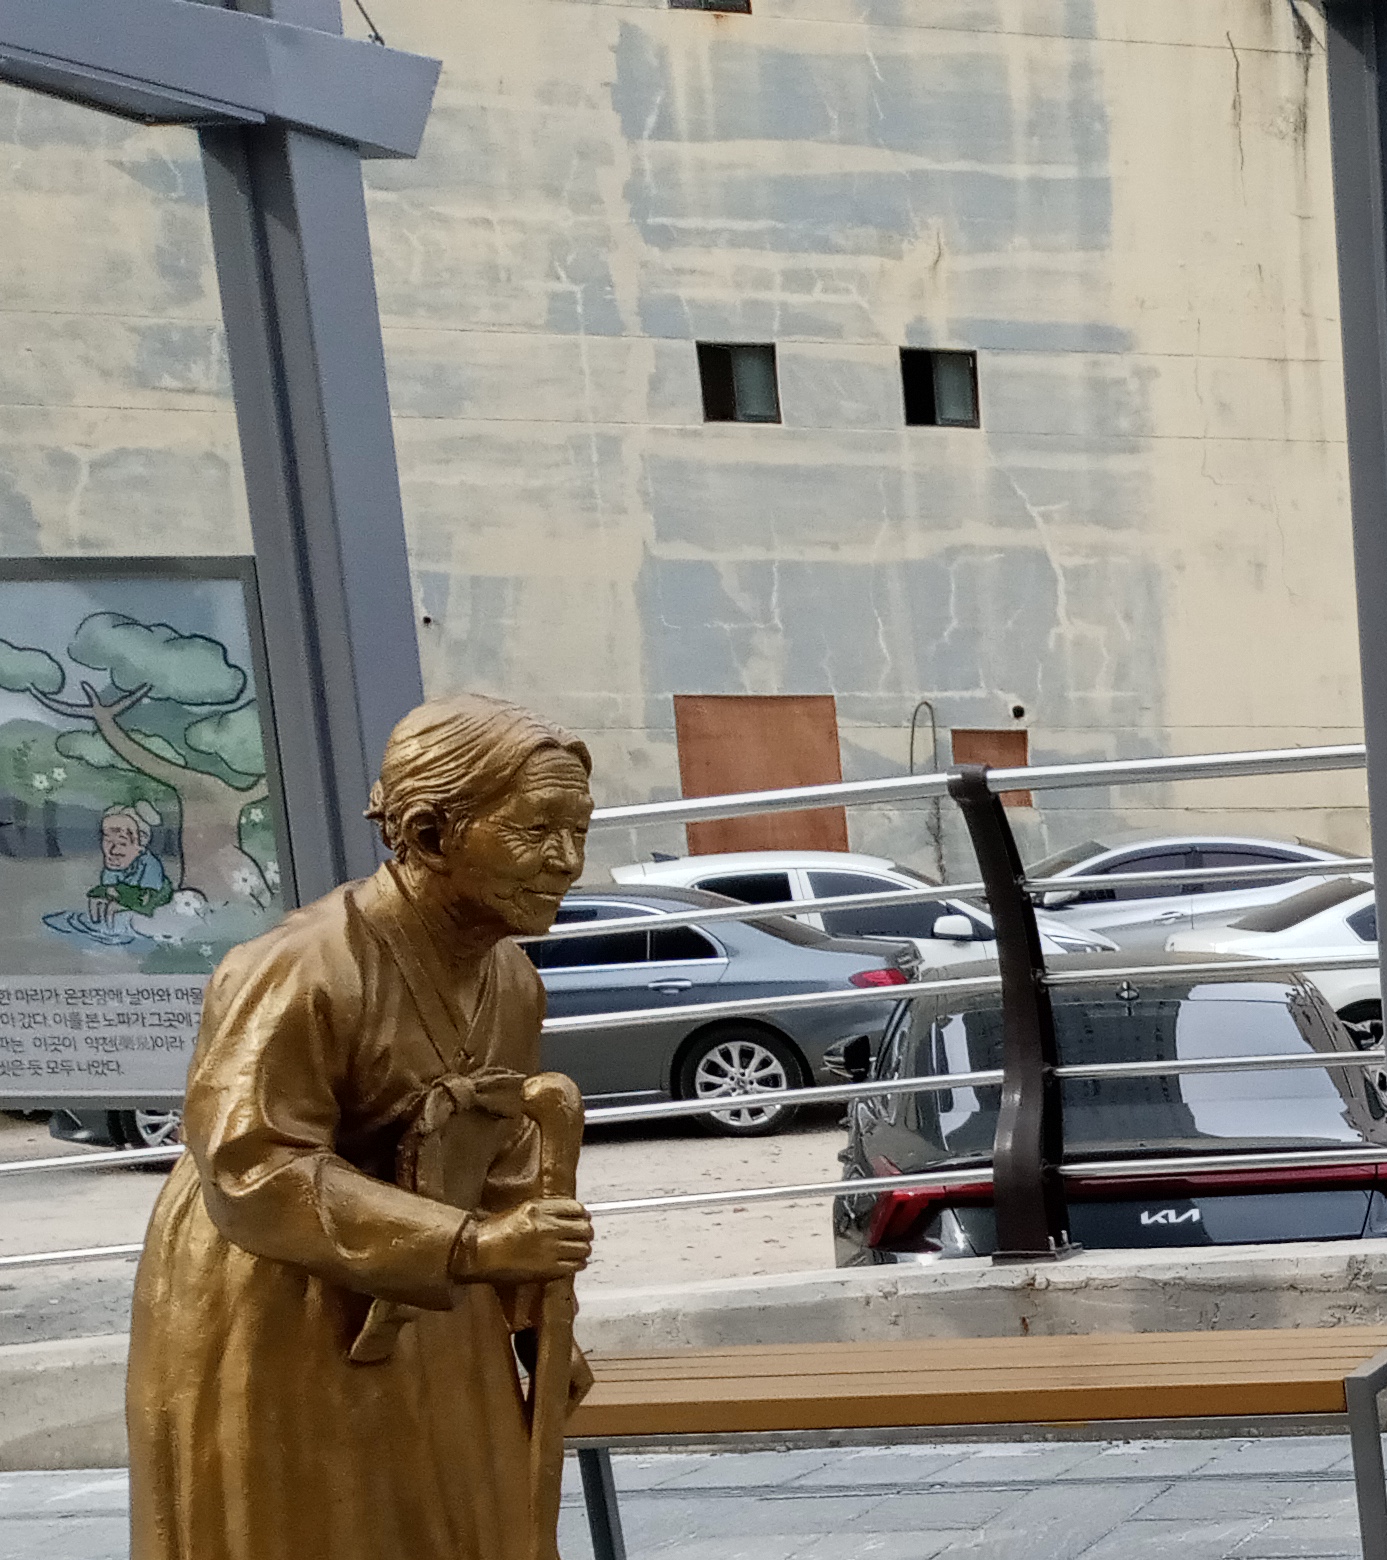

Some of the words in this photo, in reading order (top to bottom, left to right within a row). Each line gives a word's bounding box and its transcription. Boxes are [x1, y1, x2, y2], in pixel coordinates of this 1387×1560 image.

[15, 988, 61, 1004] 마리가
[126, 988, 170, 1006] 날아와
[85, 1012, 100, 1029] 본
[103, 1012, 146, 1027] 노파가
[33, 1036, 77, 1053] 이곳이
[46, 1060, 76, 1077] 모두
[1140, 1208, 1200, 1225] KIA
